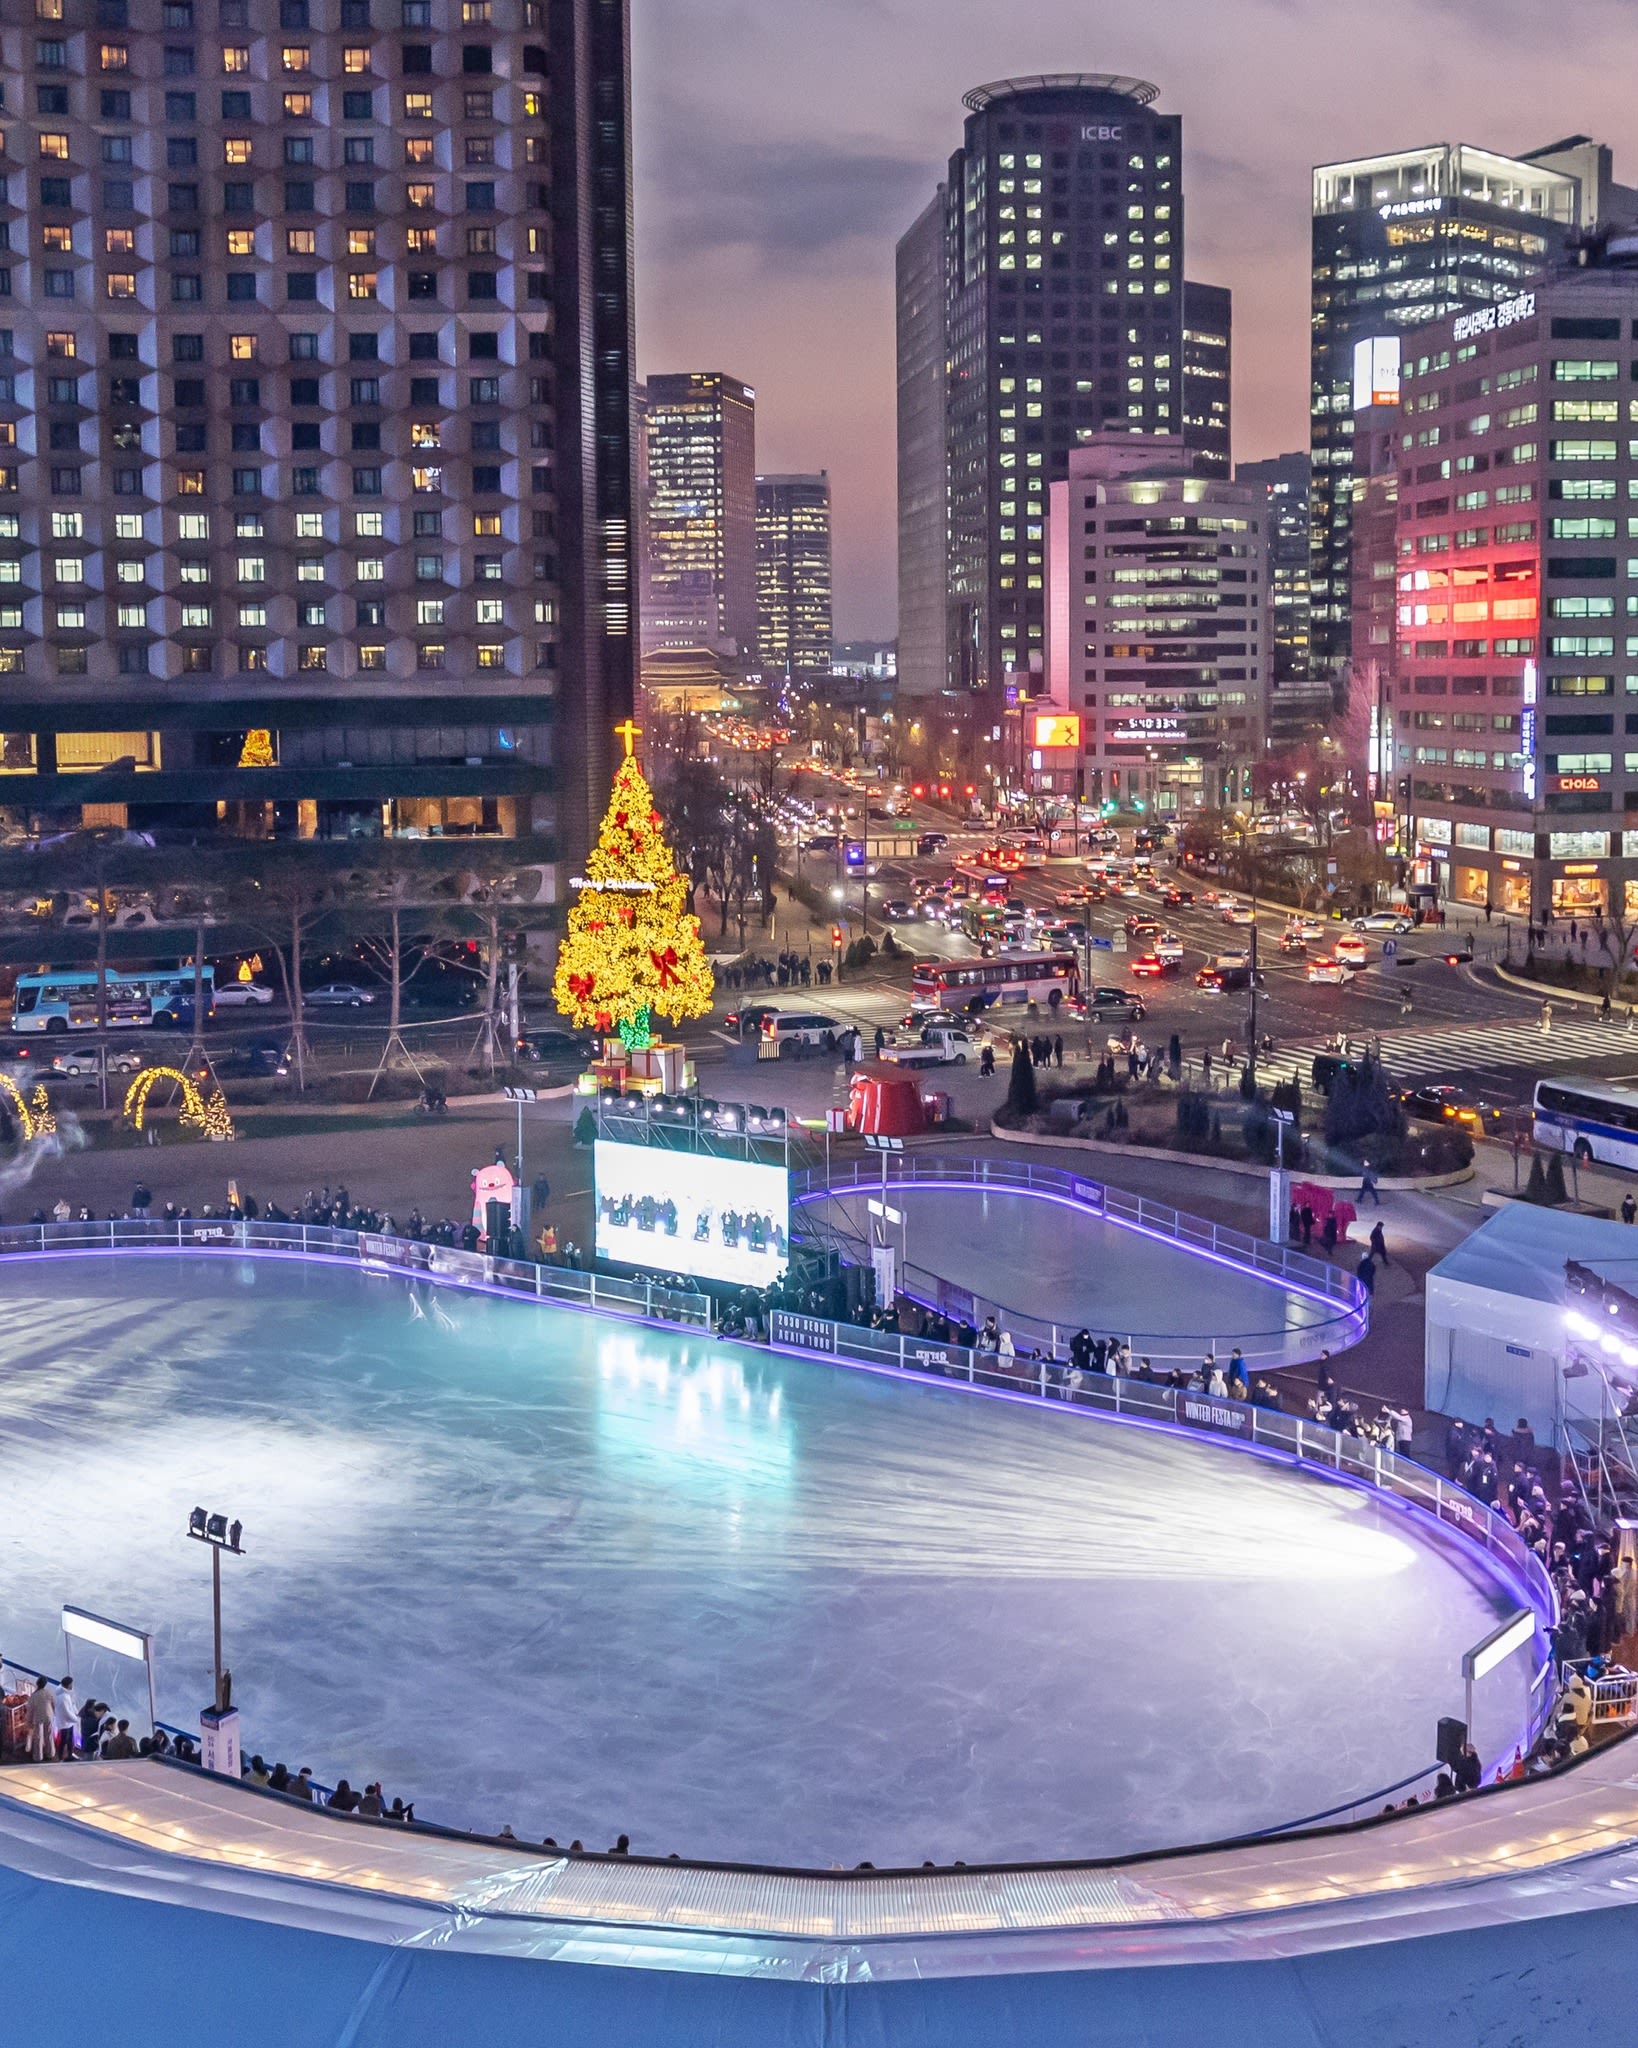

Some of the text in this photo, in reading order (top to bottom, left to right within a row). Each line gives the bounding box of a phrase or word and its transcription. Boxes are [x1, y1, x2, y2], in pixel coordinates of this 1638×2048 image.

[1081, 126, 1122, 140] ICBC
[1497, 293, 1535, 329] 경동대학교
[1560, 778, 1599, 790] 다이소
[778, 1314, 829, 1335] 2030 SEOUL
[778, 1329, 805, 1345] AGAIN
[1185, 1401, 1211, 1423] WINTER
[1211, 1407, 1232, 1428] FESTA
